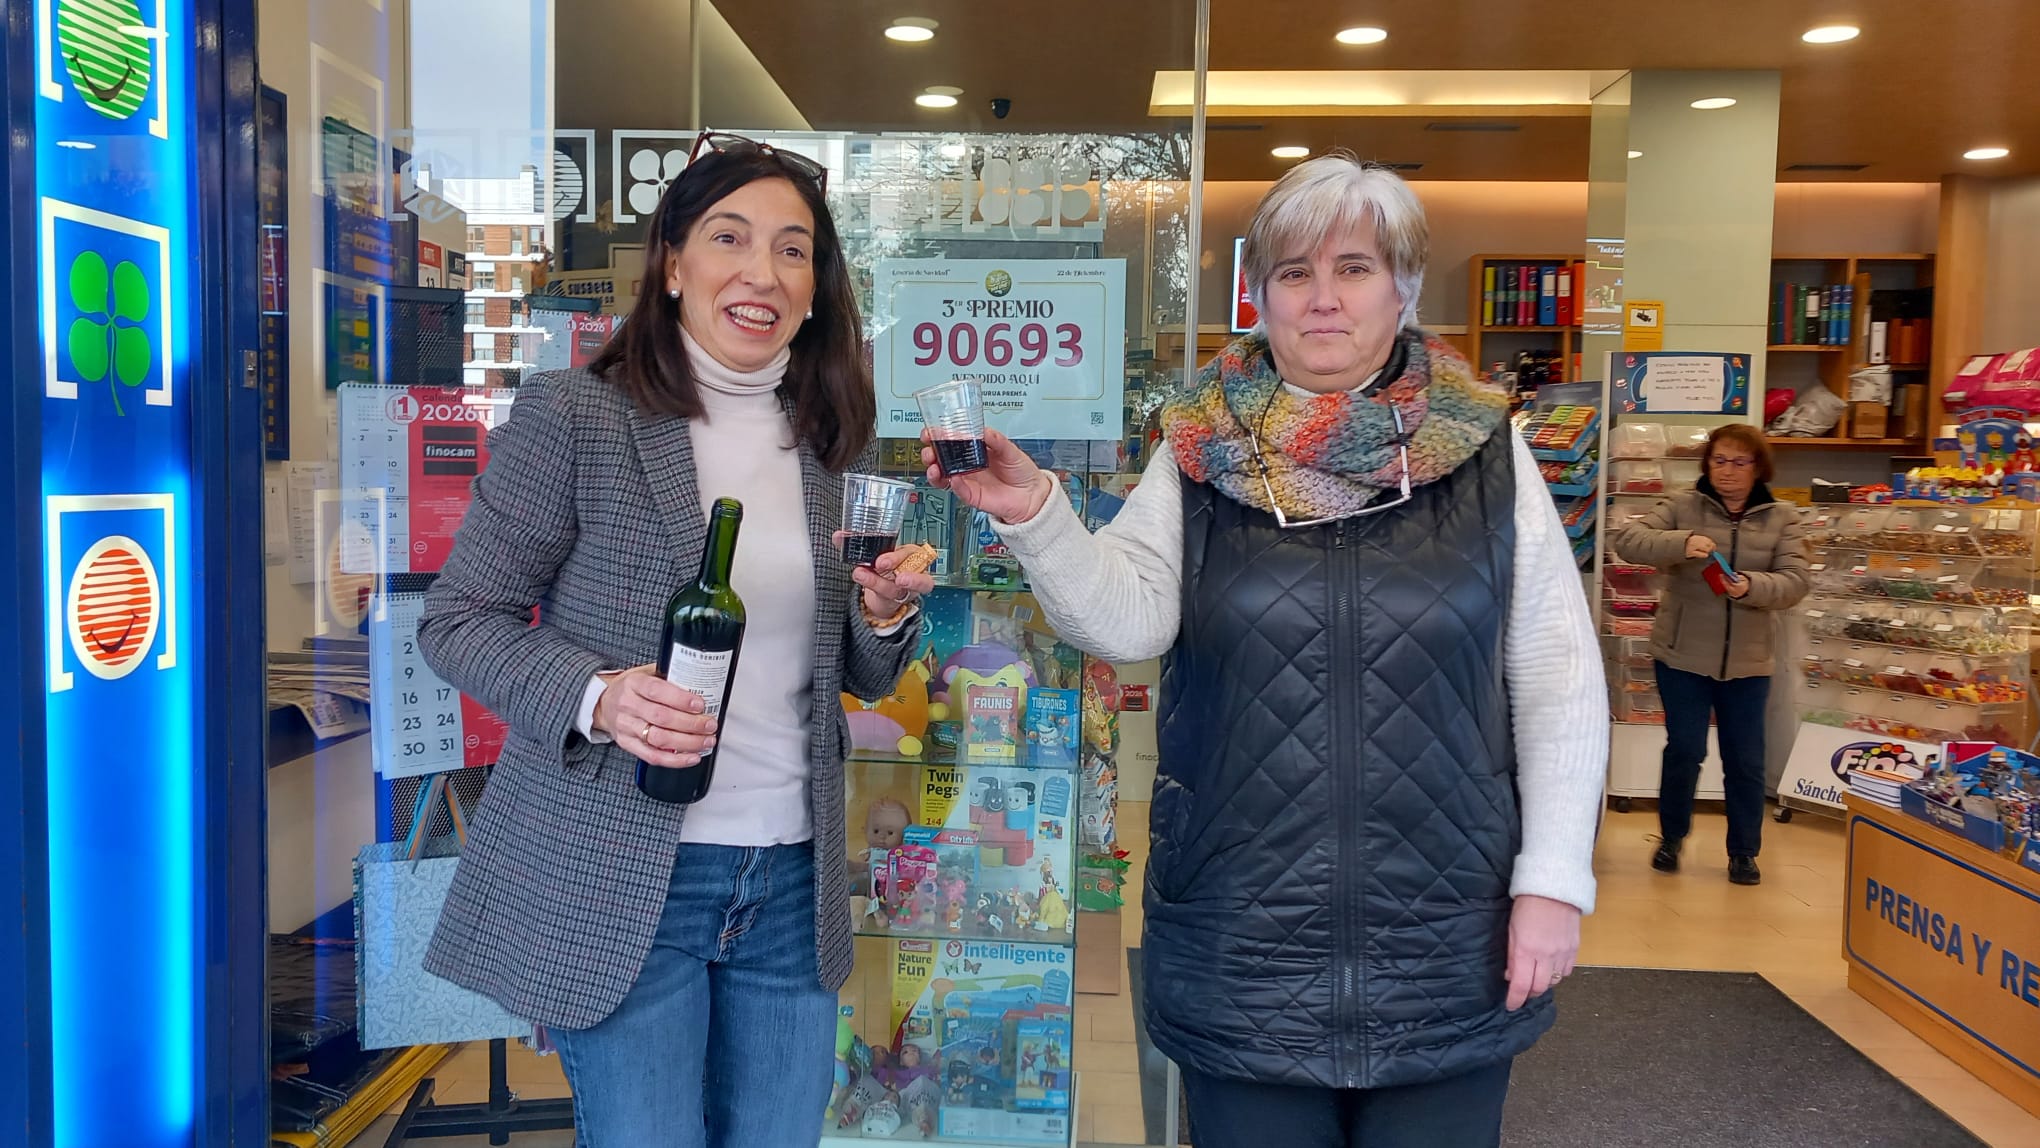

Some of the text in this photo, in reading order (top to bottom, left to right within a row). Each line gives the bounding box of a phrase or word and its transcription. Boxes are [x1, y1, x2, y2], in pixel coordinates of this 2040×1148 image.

[966, 299, 1054, 318] PREMIO
[579, 322, 605, 332] 2026
[913, 322, 1084, 367] 90693
[422, 404, 478, 422] 2026
[426, 446, 476, 458] finocam
[403, 641, 413, 655] 2
[404, 667, 414, 680] 9
[402, 688, 451, 705] 16 17
[973, 697, 1013, 709] FAUNIS
[1032, 697, 1067, 711] TIBURONES
[403, 713, 455, 731] 23 24
[403, 738, 455, 756] 30 31
[927, 768, 964, 783] Twin
[926, 783, 960, 798] Pegs
[1794, 778, 1843, 804] Sánche
[1866, 877, 1965, 965] PRENSA
[1972, 932, 1993, 976] Y
[898, 953, 932, 964] Nature
[964, 940, 1066, 965] intelligente
[897, 963, 926, 976] Fun
